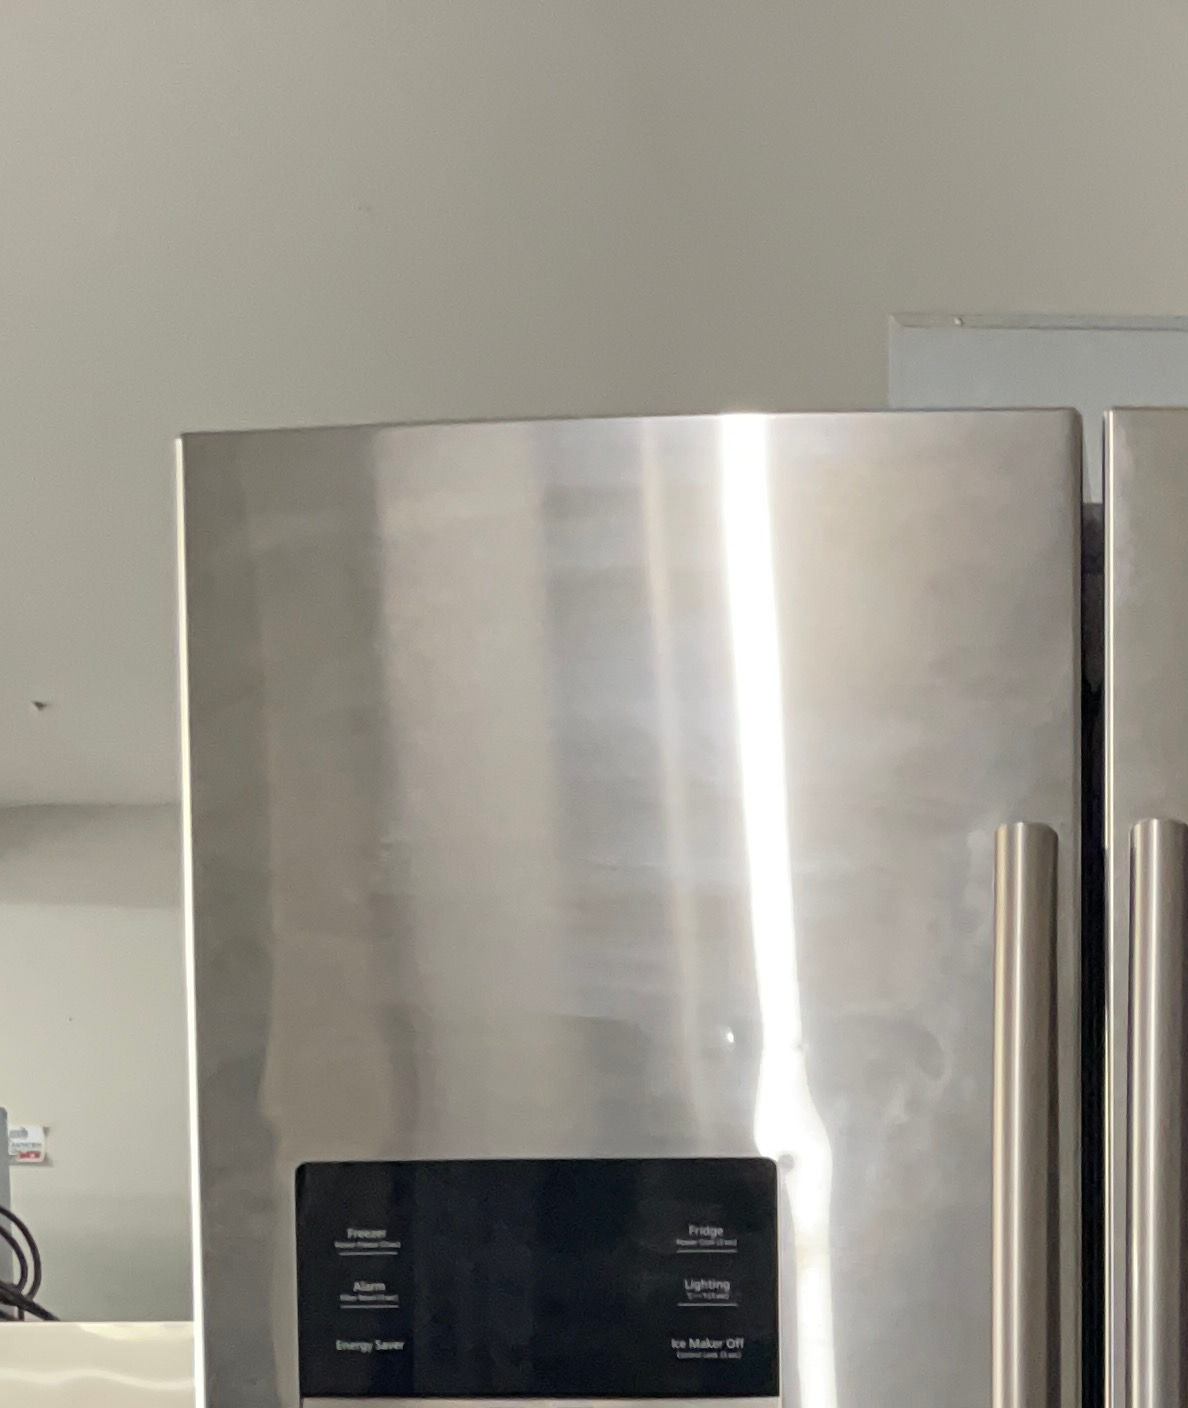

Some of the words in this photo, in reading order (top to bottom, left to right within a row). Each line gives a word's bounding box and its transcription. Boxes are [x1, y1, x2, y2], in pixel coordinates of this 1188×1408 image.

[347, 1228, 387, 1239] Freezer
[688, 1225, 724, 1239] Fridge
[353, 1280, 386, 1292] Alarm
[684, 1279, 730, 1292] Lighting
[335, 1339, 373, 1354] Energy
[375, 1339, 405, 1350] Saver
[671, 1338, 686, 1349] Ice
[689, 1337, 723, 1349] Maker
[726, 1337, 744, 1349] Off
